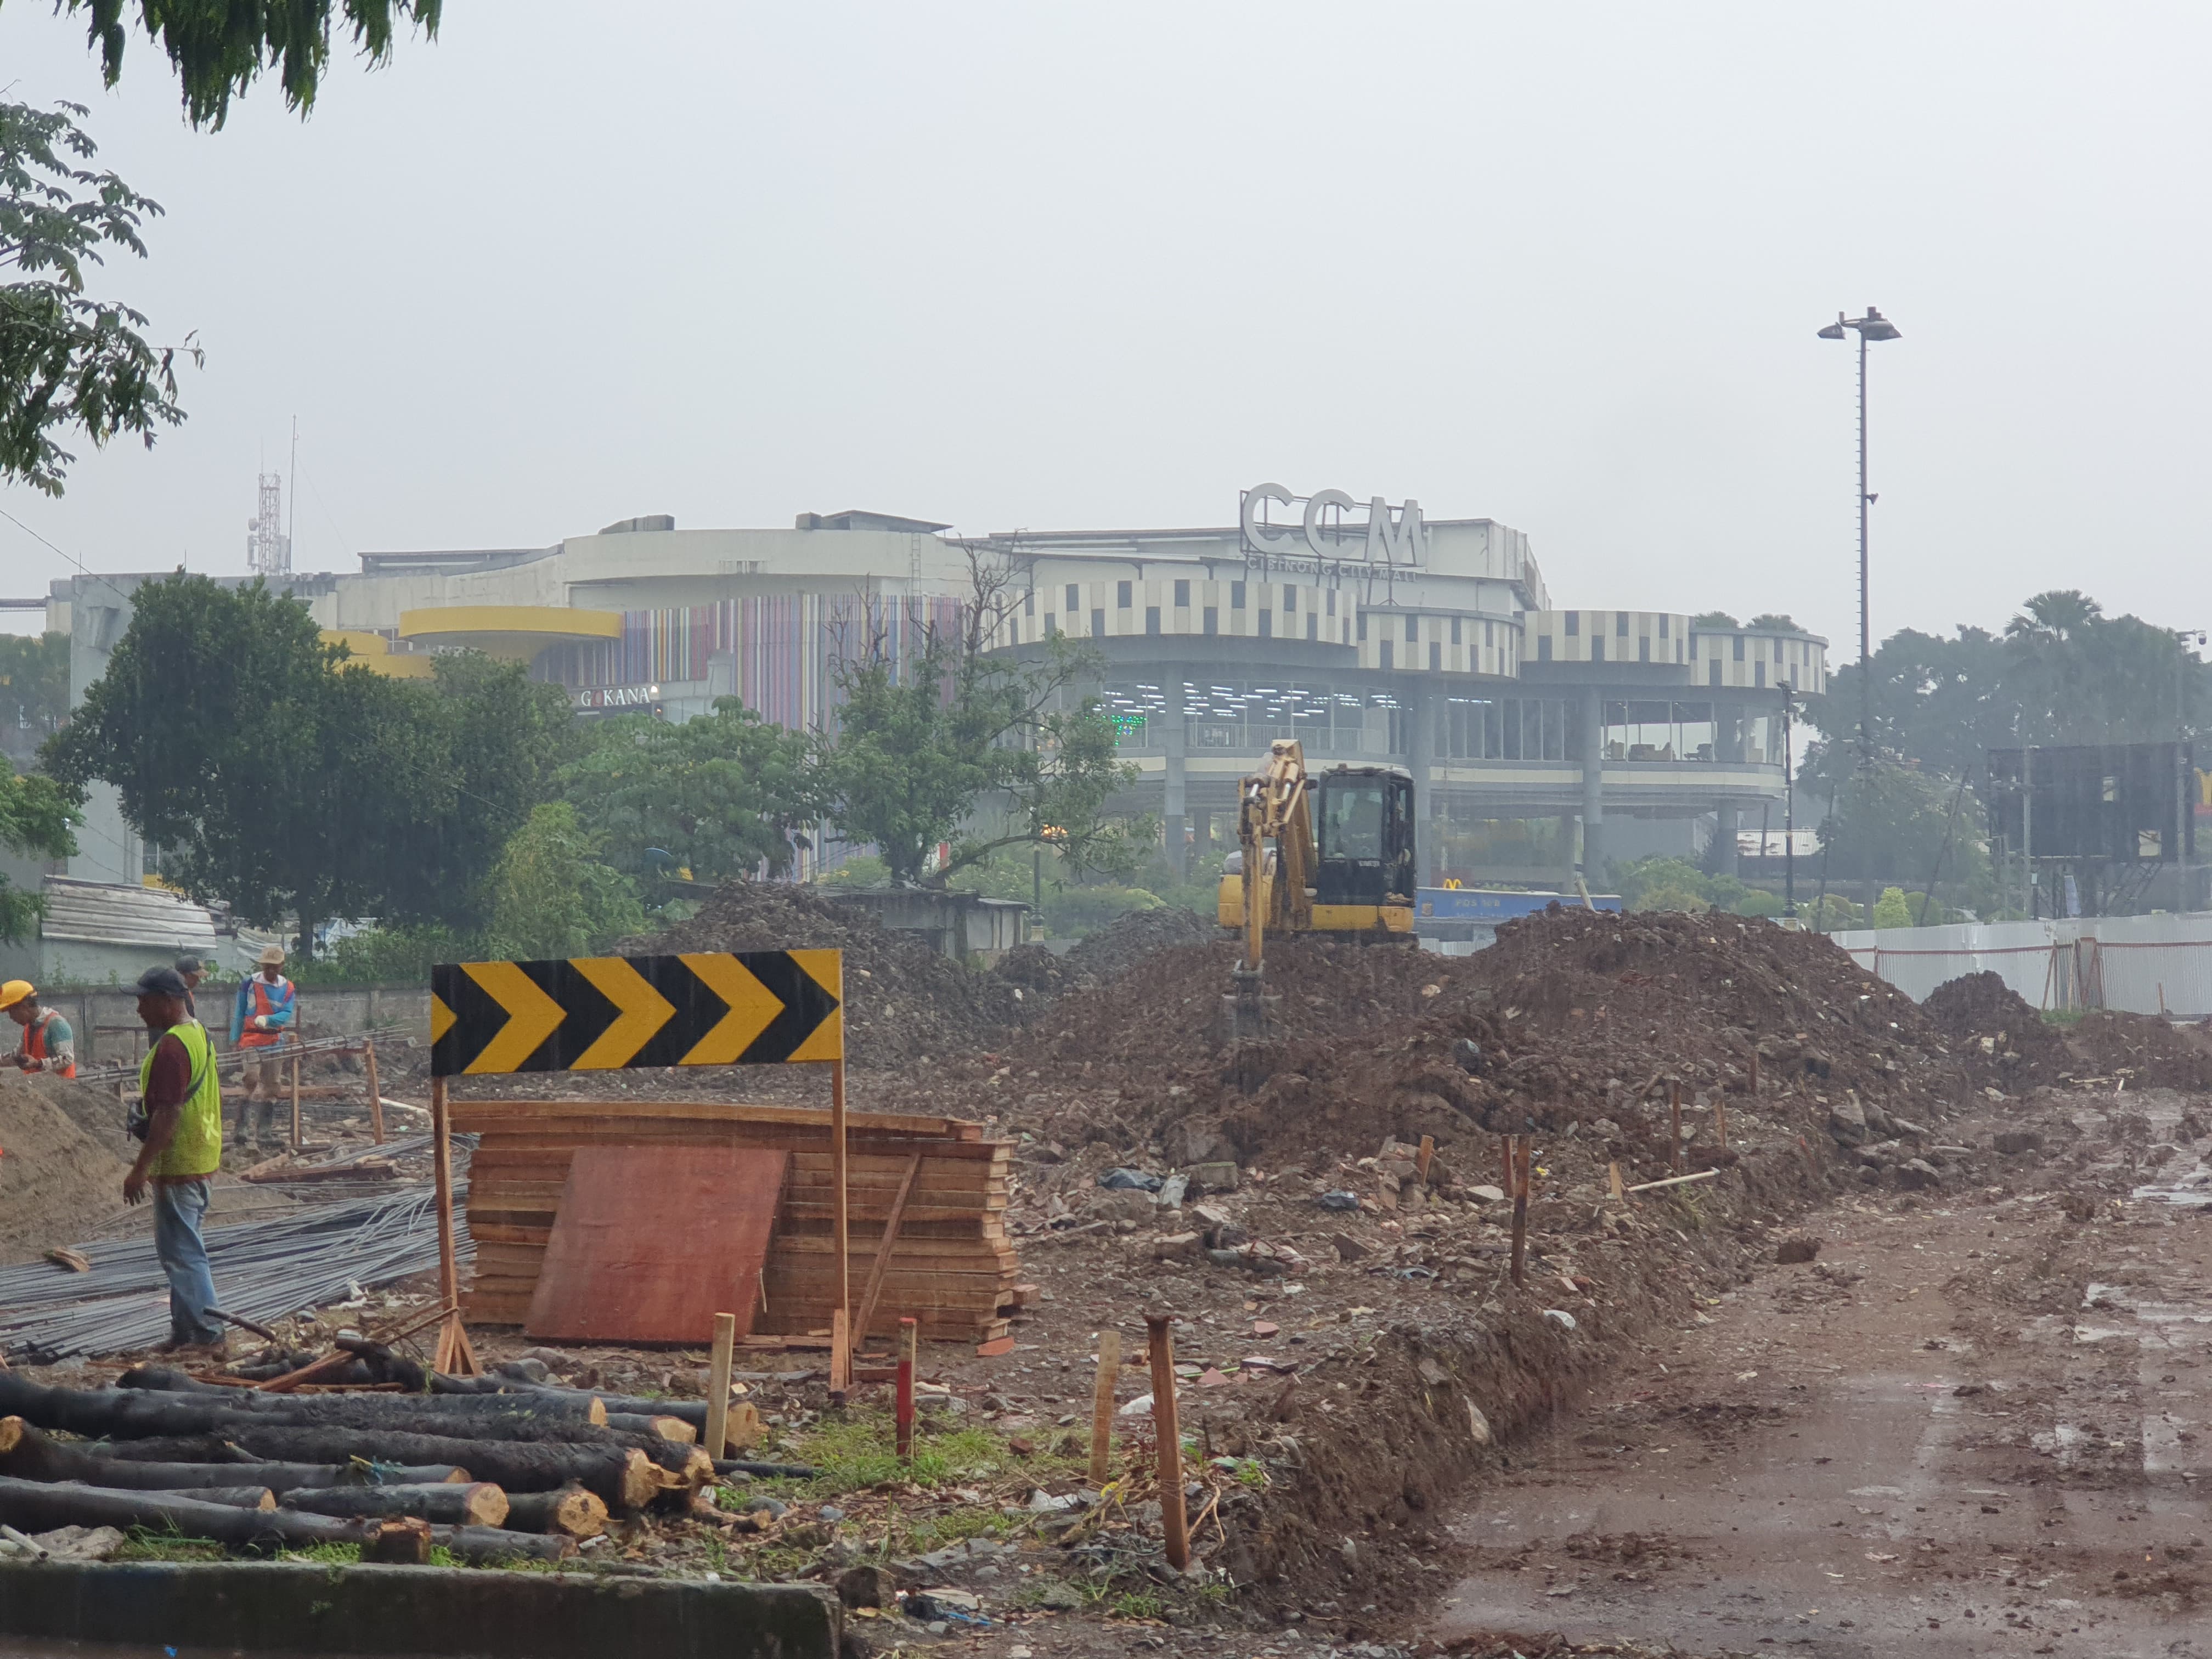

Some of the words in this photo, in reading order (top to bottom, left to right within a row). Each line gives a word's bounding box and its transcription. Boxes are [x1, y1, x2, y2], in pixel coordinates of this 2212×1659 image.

[1243, 482, 1427, 567] CCM
[1247, 556, 1332, 575] CIBINONG
[1338, 565, 1372, 578] CITY
[1379, 568, 1419, 583] MALL
[580, 688, 651, 707] GOKANA
